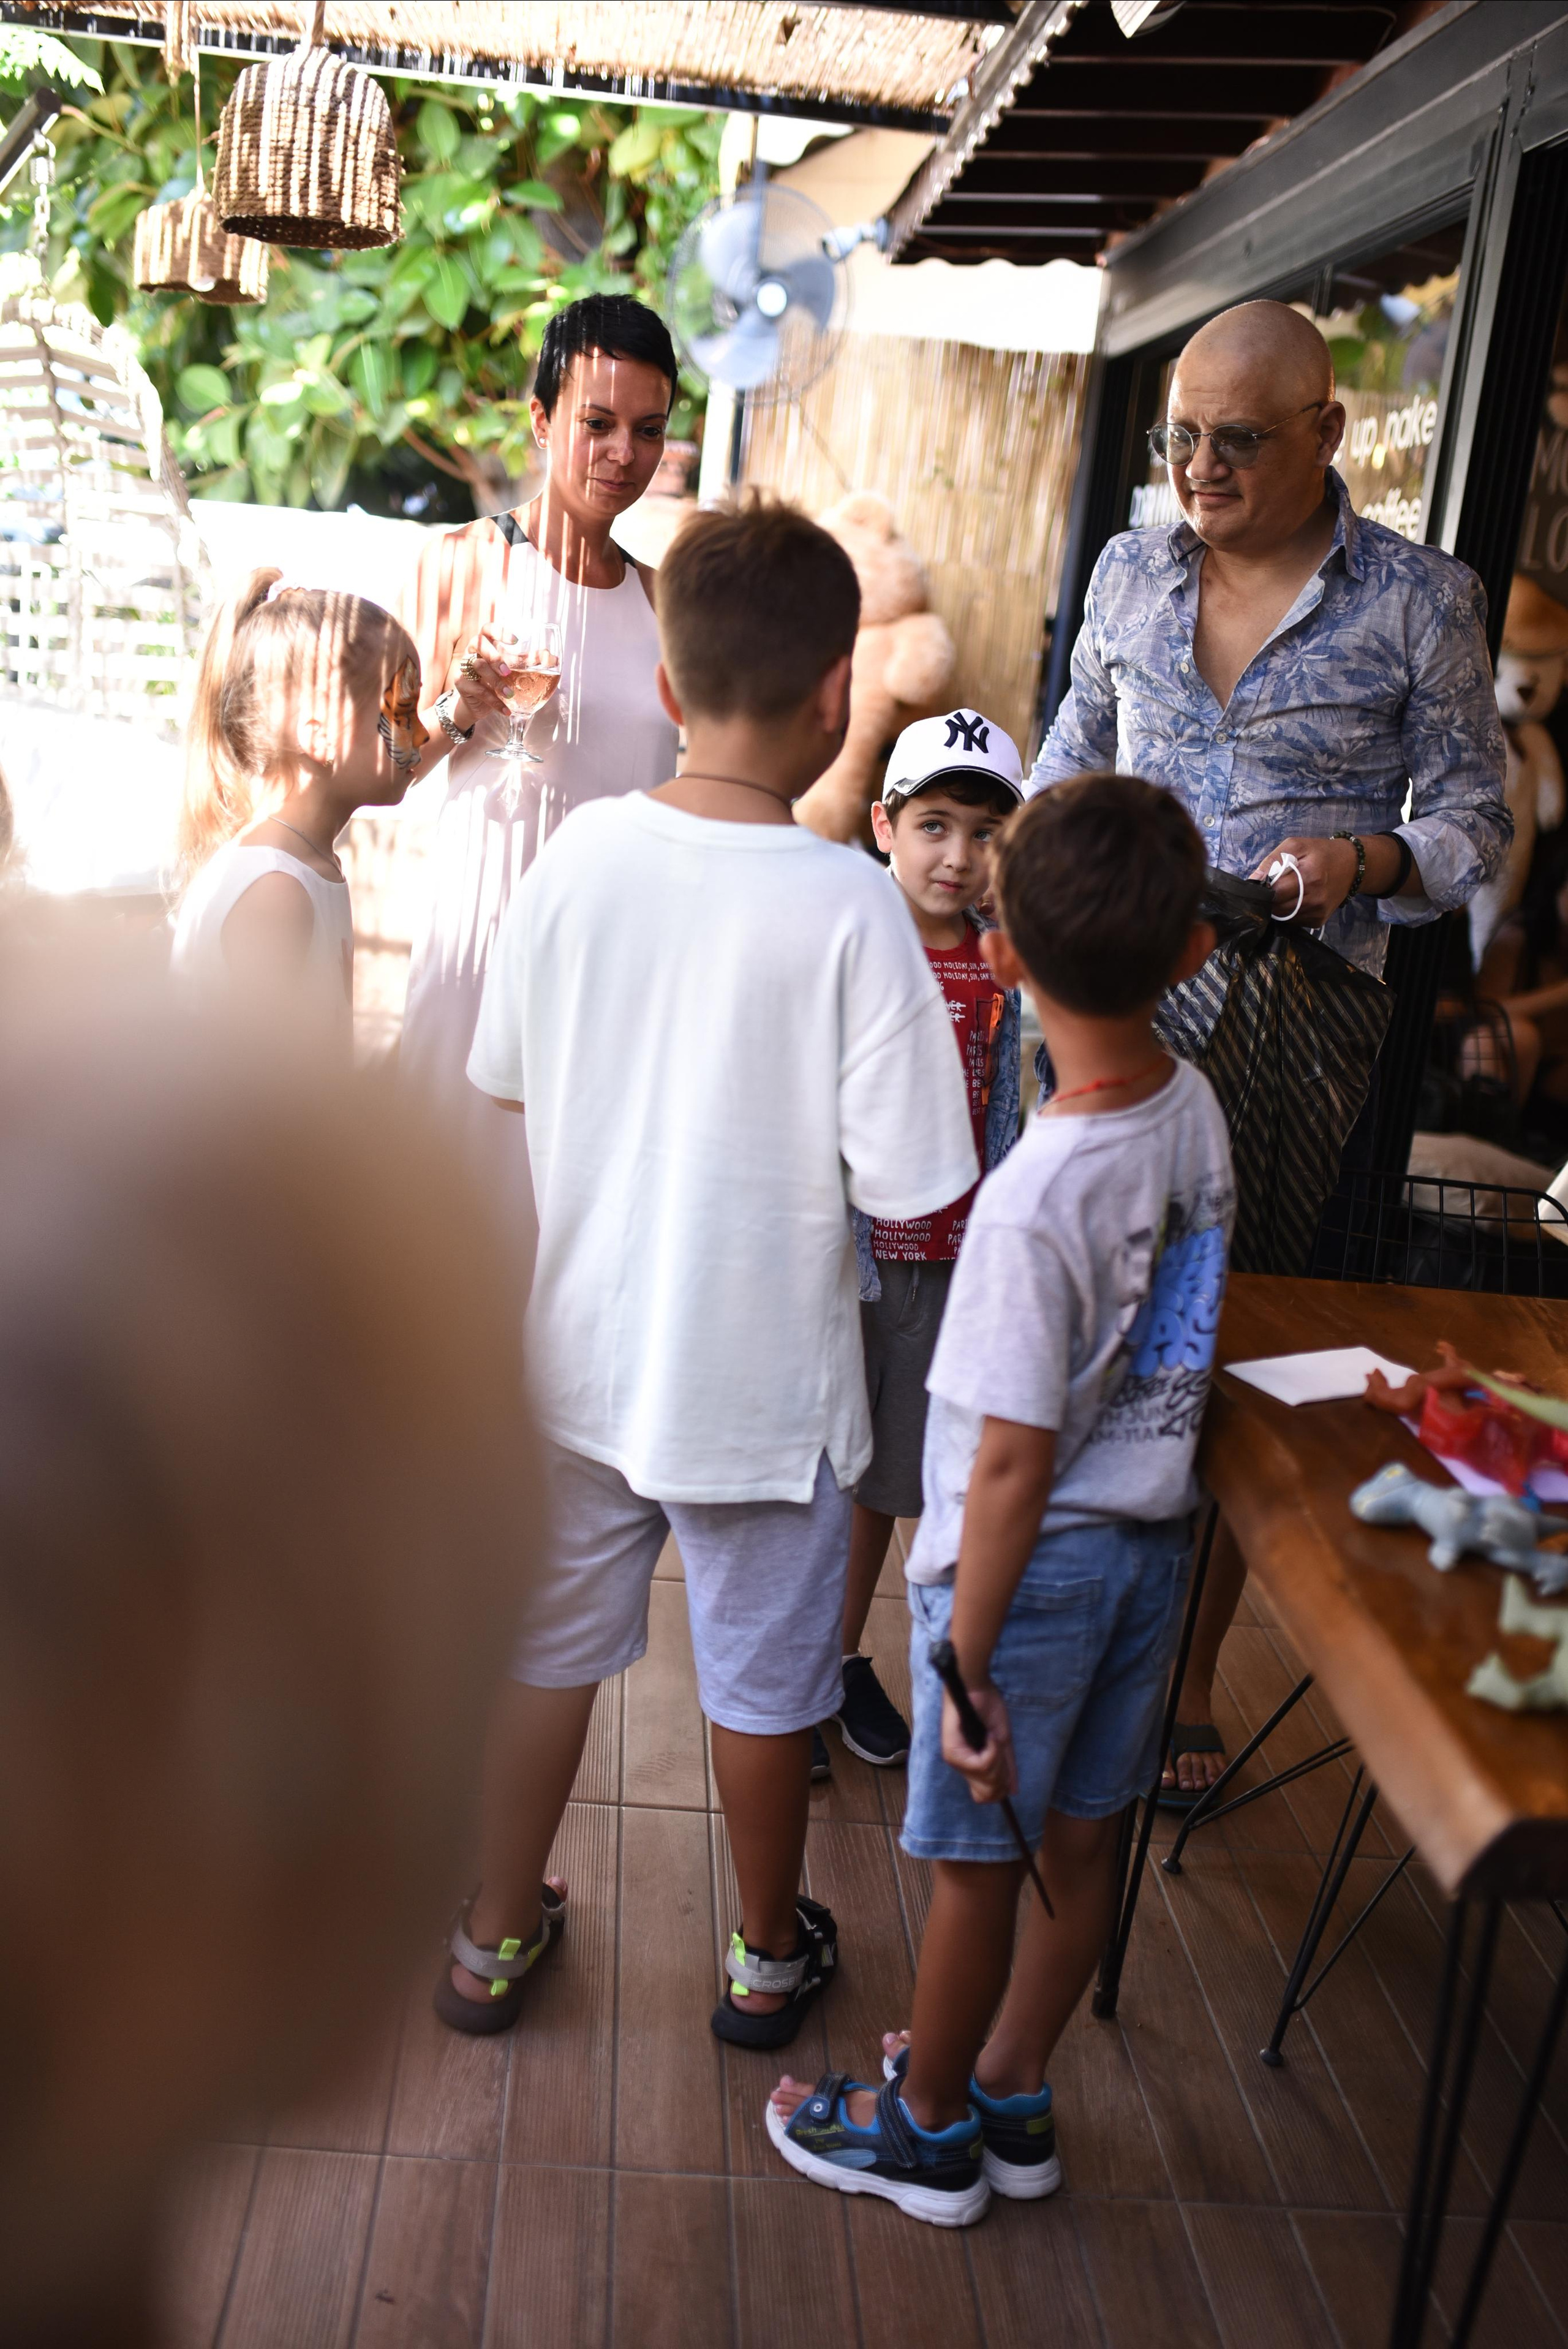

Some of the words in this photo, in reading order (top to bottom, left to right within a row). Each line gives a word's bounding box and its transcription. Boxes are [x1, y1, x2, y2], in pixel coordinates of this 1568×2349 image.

[1350, 415, 1378, 468] up
[944, 711, 990, 754] NY
[875, 1217, 932, 1230] HOLLYWOOD
[951, 1220, 968, 1231] PARI
[875, 1229, 931, 1242] HOLLYWOOD
[873, 1239, 919, 1251] HOLLYWOOD
[875, 1250, 898, 1260] NEW
[902, 1251, 927, 1261] YORK
